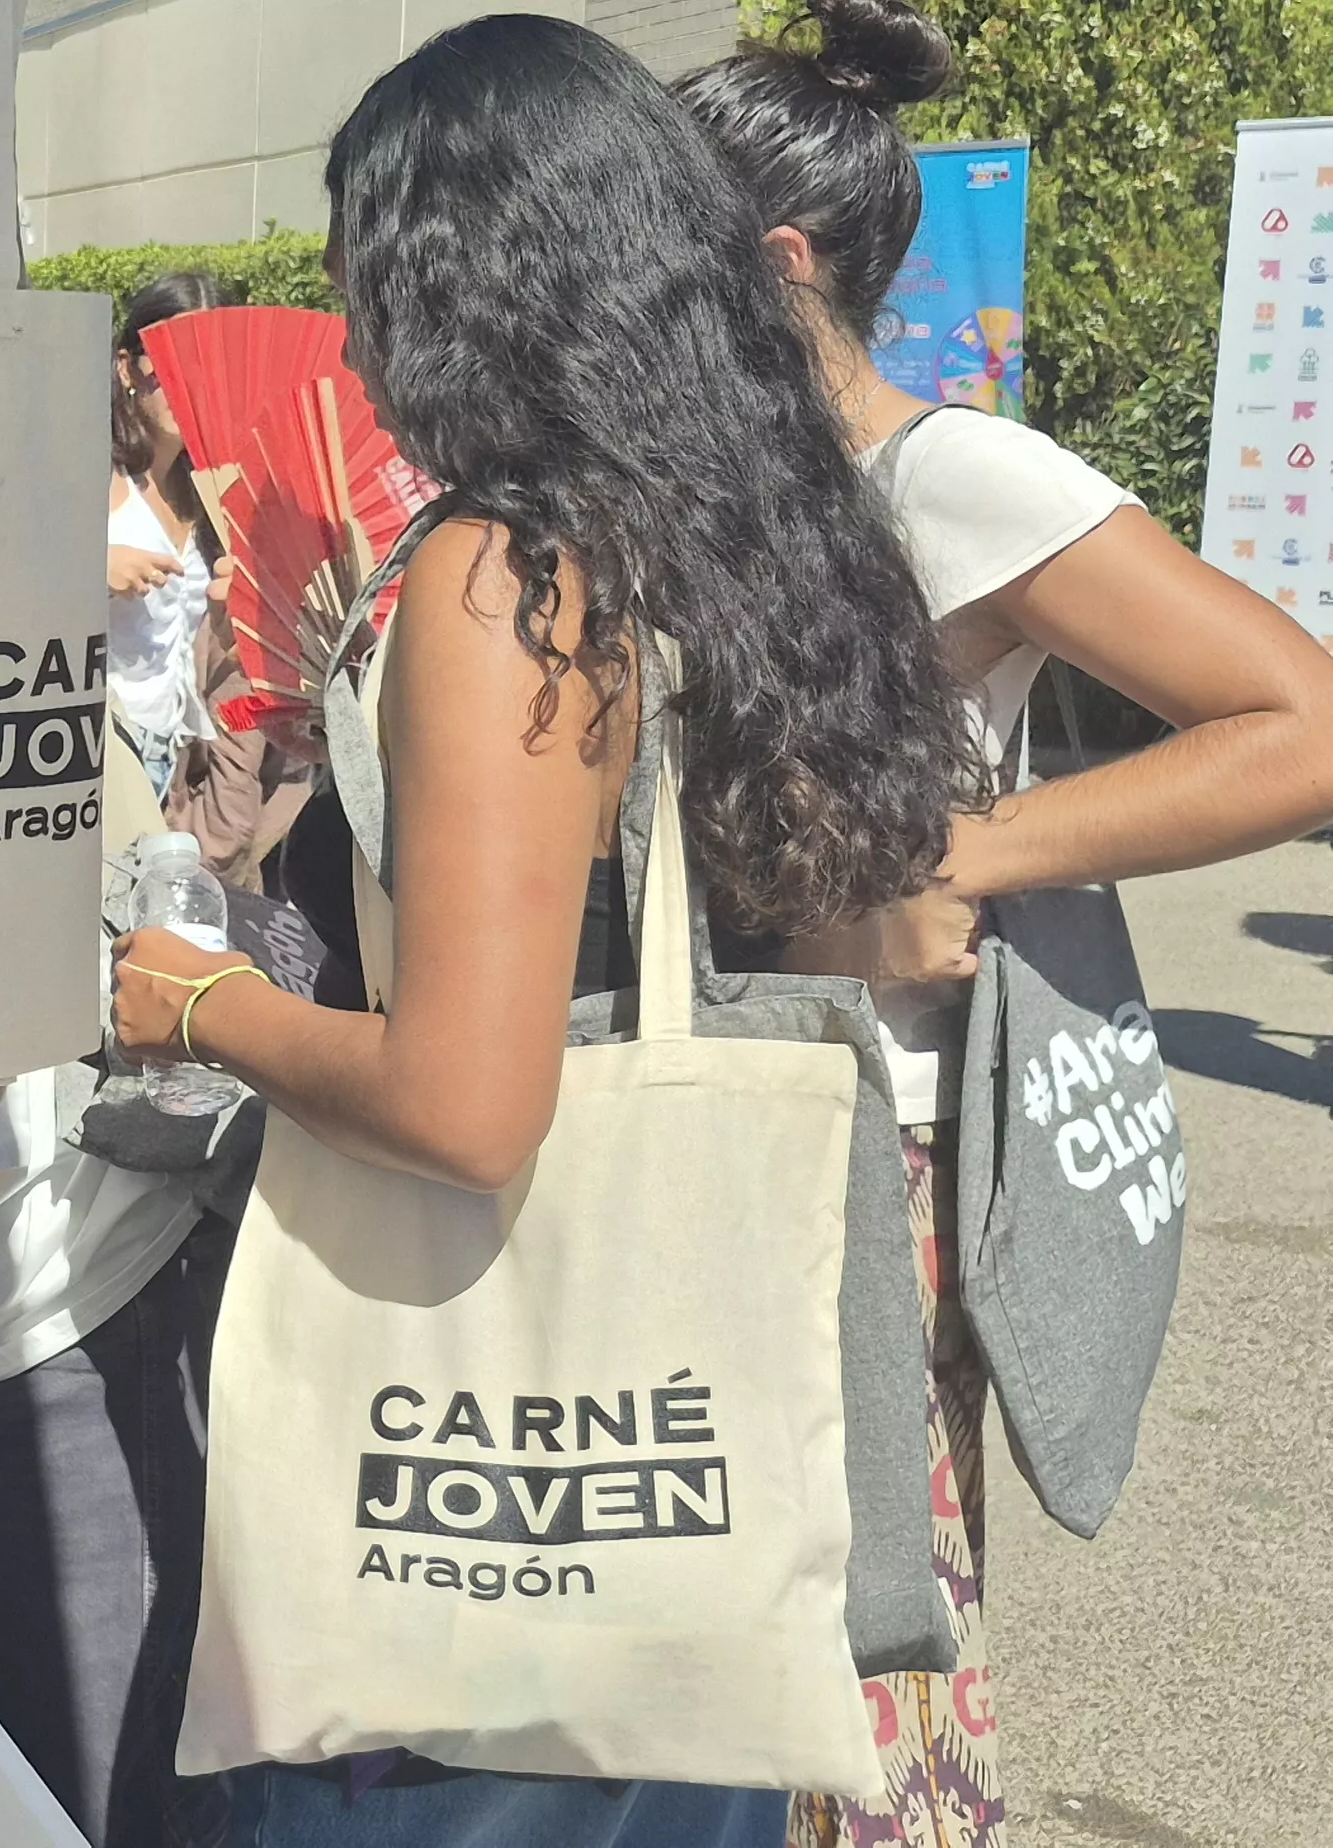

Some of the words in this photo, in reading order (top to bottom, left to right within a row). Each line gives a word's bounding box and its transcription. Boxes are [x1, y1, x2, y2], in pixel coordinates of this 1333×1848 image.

[370, 1367, 716, 1452] CARNÉ
[364, 1457, 725, 1536] JOVEN
[356, 1543, 596, 1602] Aragón
